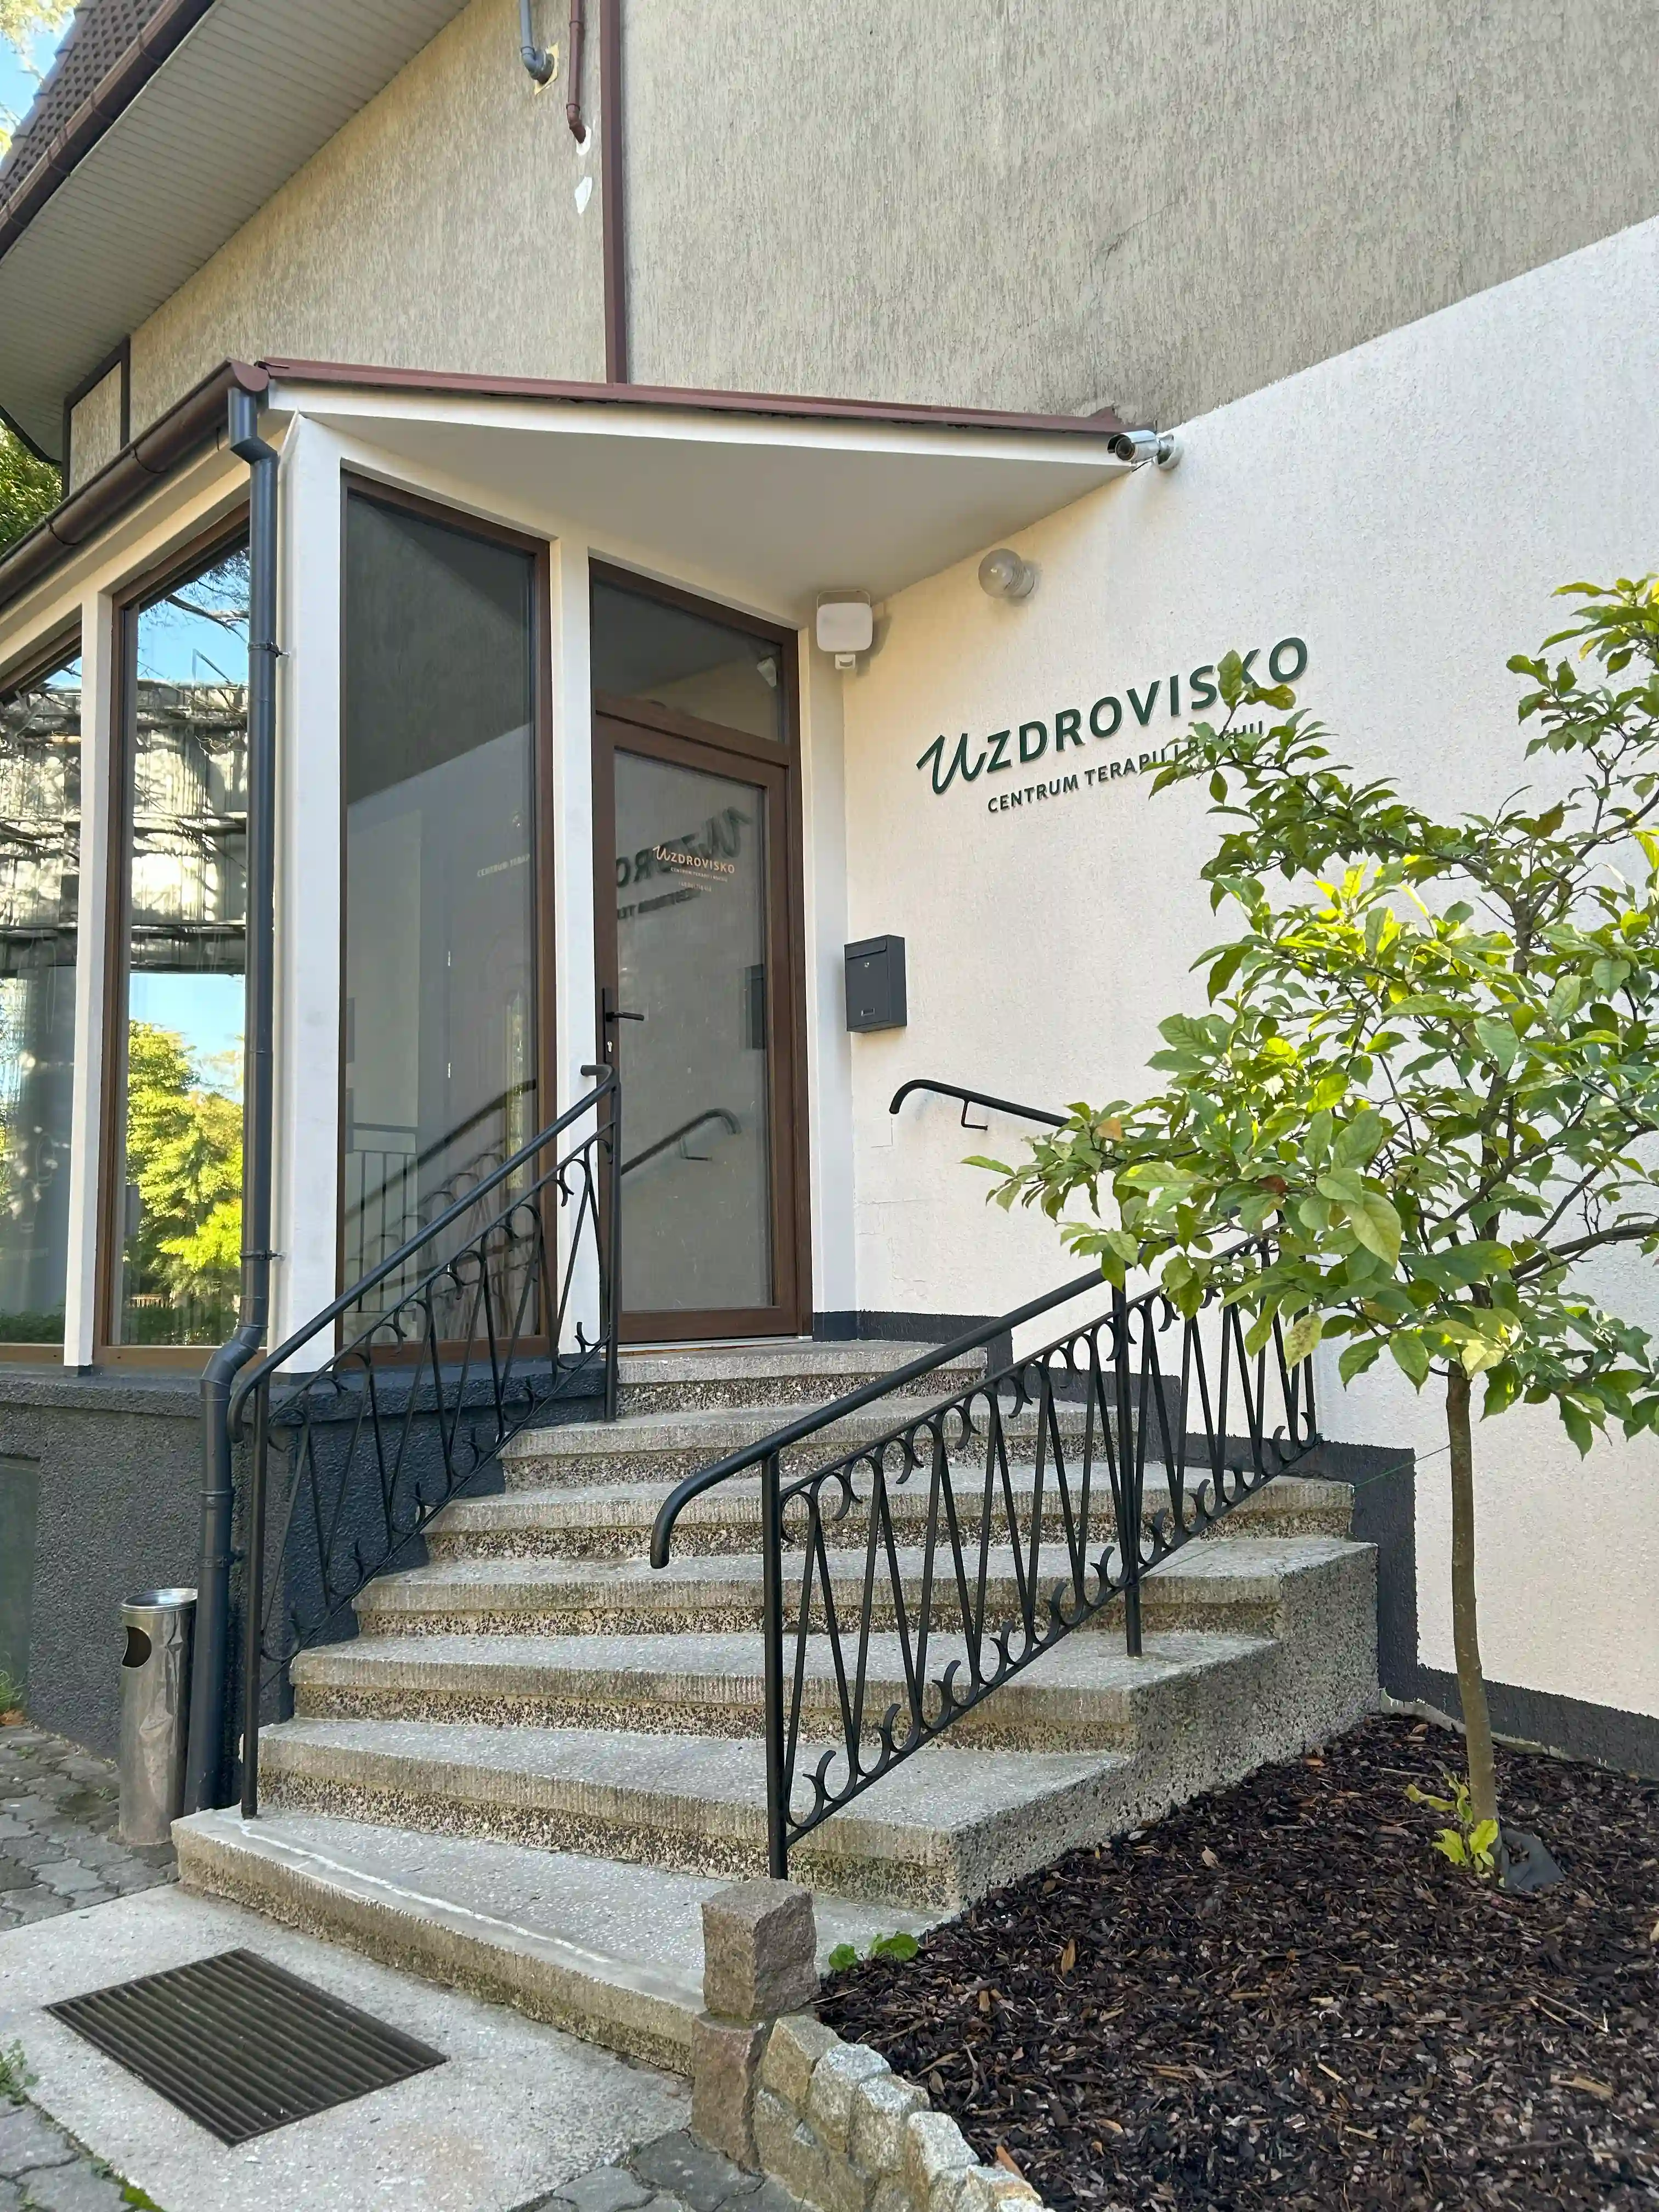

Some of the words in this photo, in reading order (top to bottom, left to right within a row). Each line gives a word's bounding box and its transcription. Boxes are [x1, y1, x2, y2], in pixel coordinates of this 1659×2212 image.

[916, 637, 1308, 794] UZDROVISKO
[988, 774, 1079, 813] CENTRUM
[652, 845, 735, 874] UZDROVISKO
